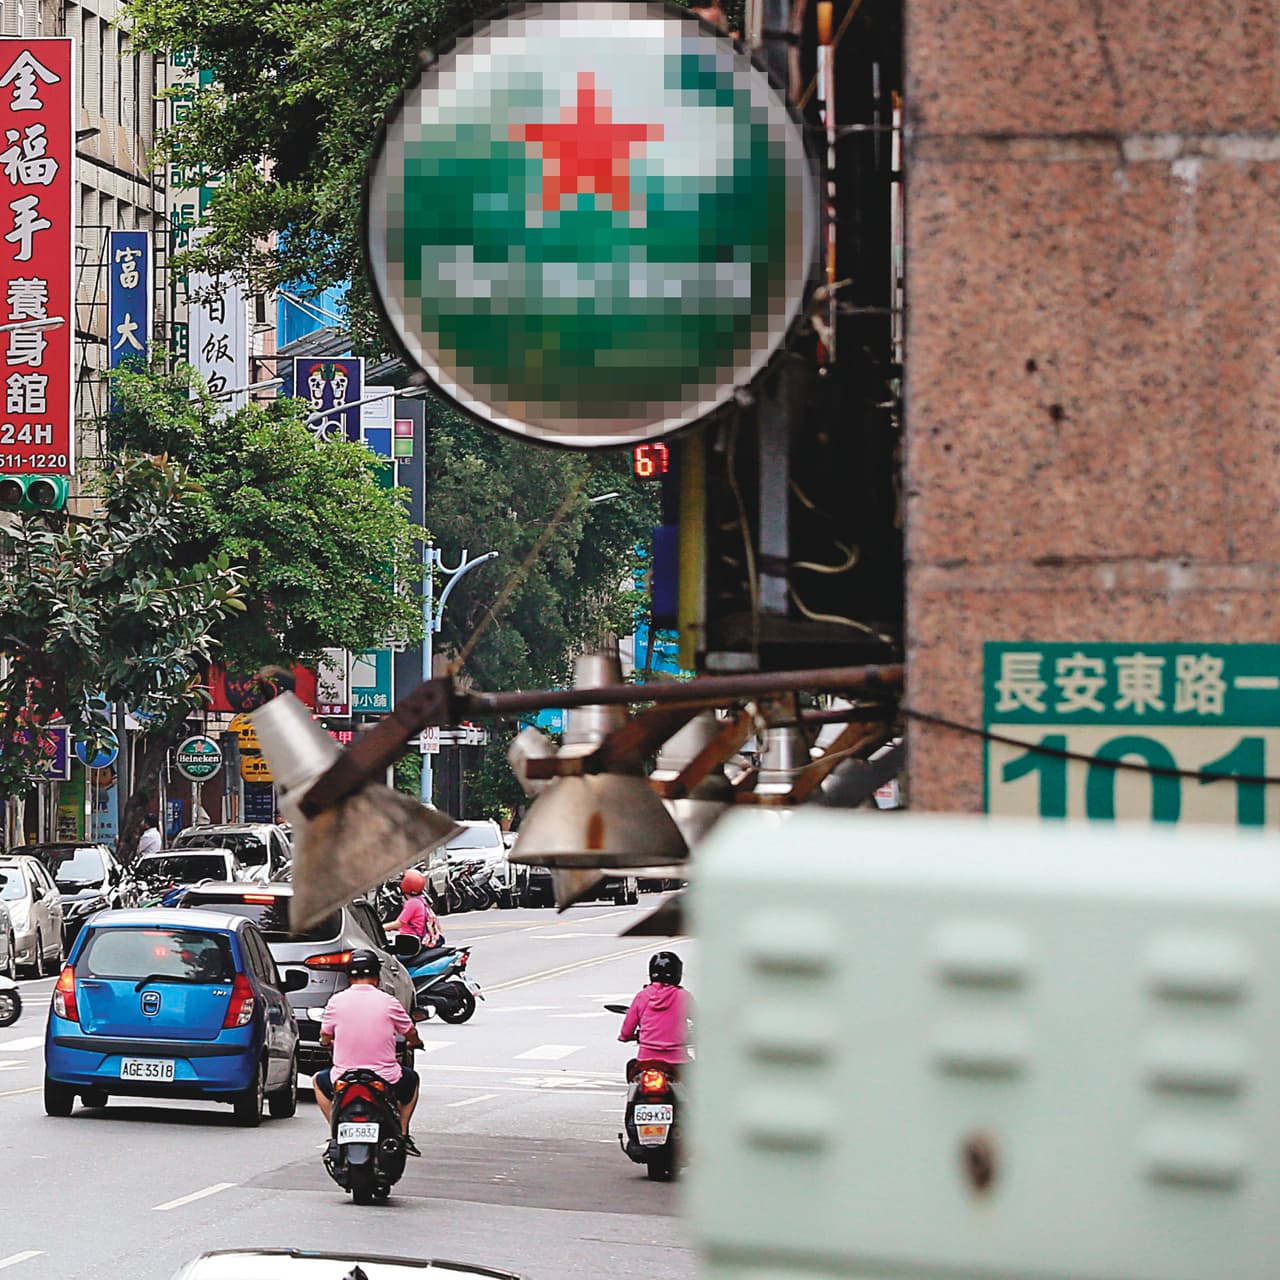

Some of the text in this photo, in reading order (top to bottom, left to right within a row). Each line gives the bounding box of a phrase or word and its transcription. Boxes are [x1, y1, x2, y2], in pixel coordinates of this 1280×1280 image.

[0, 423, 53, 445] 24H
[994, 651, 1279, 716] 長安東路一
[178, 754, 221, 764] Heineken
[122, 1062, 173, 1078] AGE-3318
